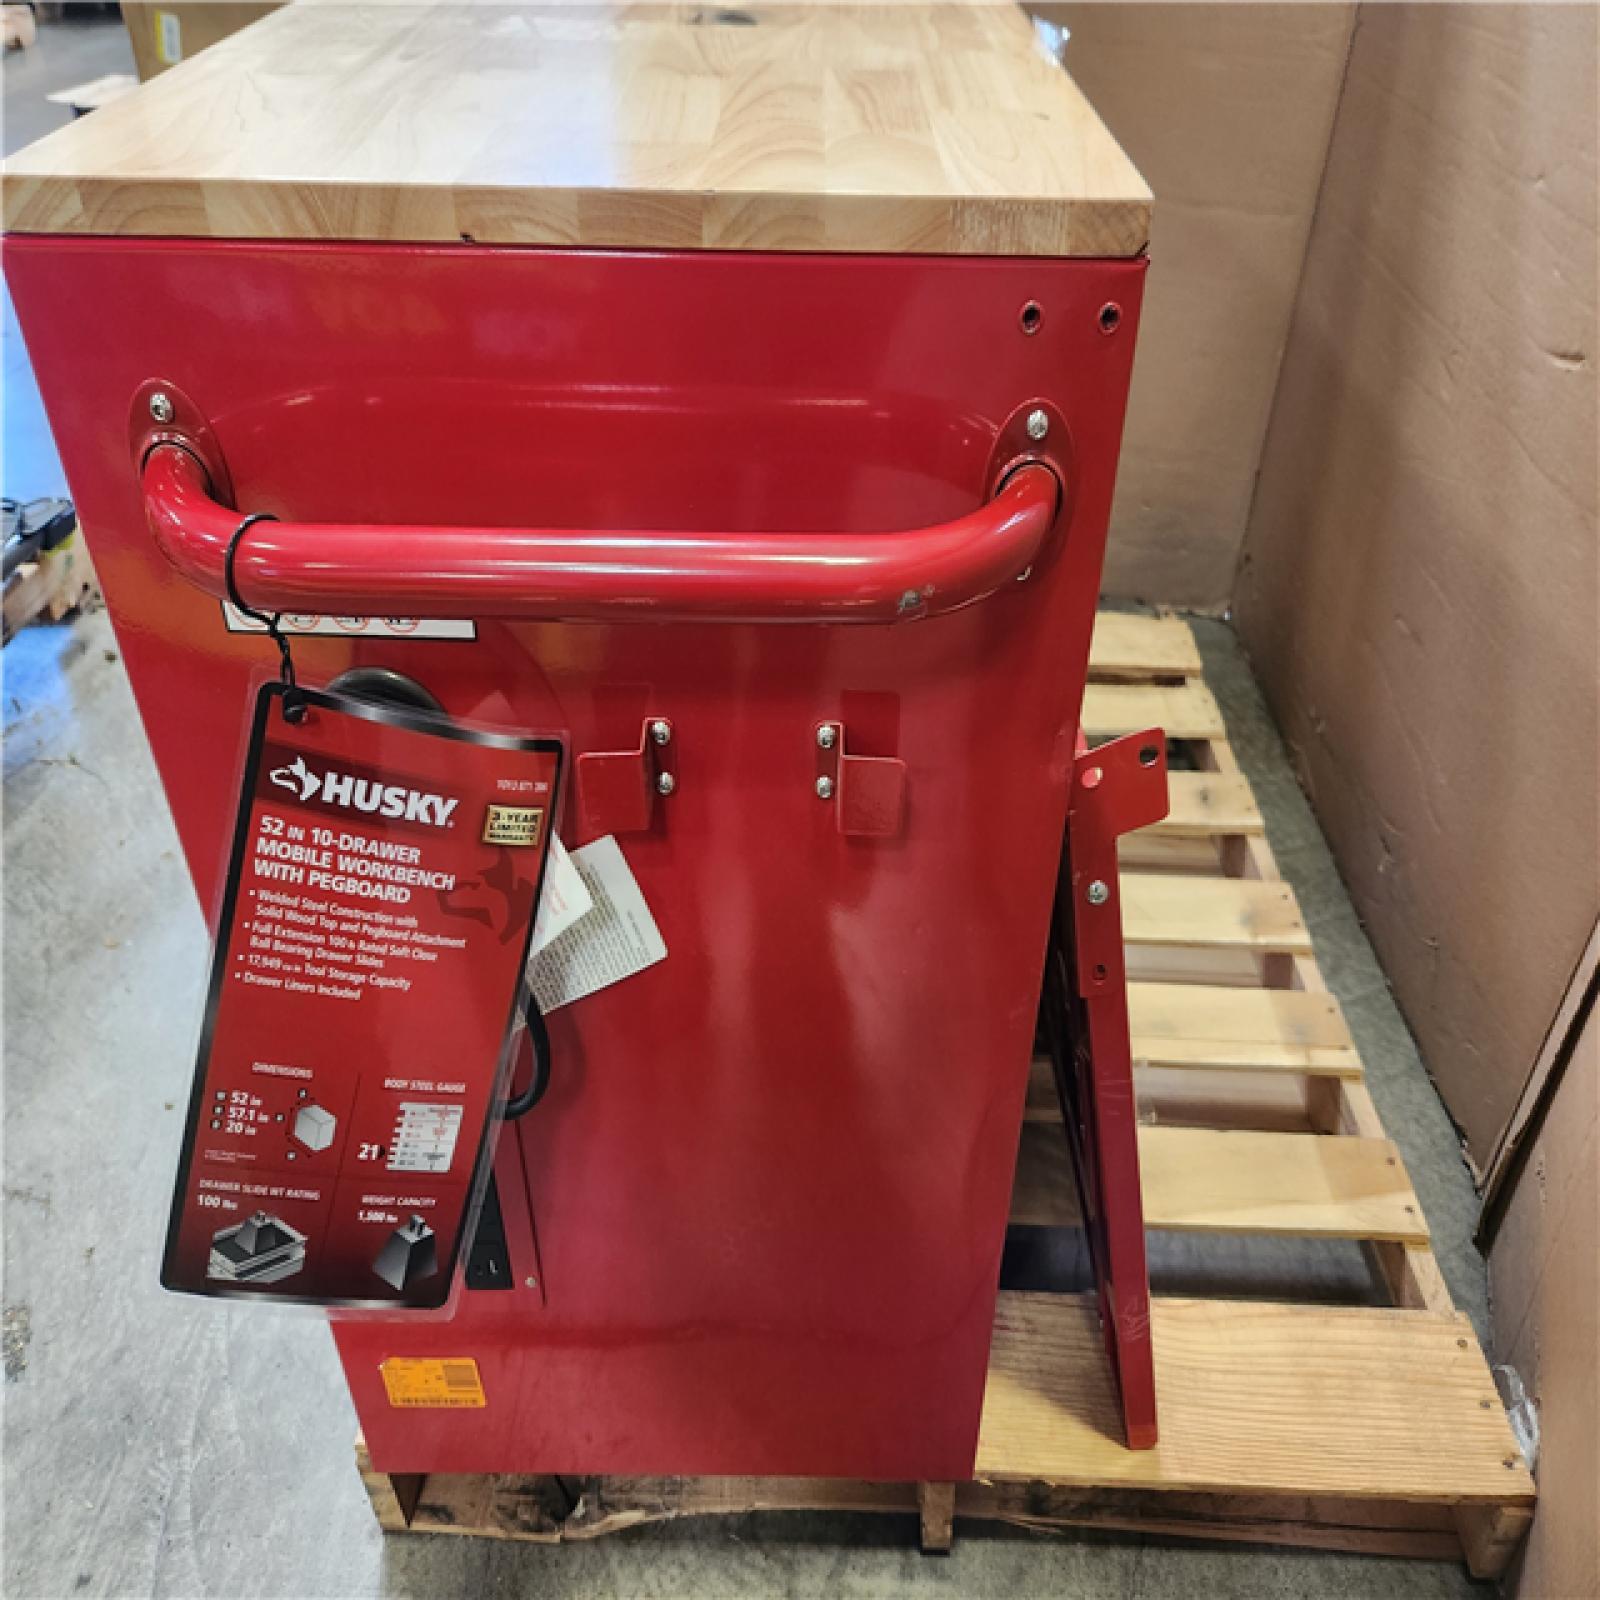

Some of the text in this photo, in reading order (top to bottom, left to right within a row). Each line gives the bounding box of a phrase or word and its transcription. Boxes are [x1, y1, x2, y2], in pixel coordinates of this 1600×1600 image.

[321, 771, 458, 826] HUSKY
[260, 815, 284, 836] 52
[311, 827, 421, 865] 10-DRAWER
[256, 837, 456, 891] MOBILE WORKBENCH
[253, 858, 411, 903] WITH PEGBOARD
[258, 889, 418, 928] Welded Steel Construction with
[252, 920, 273, 935] Full
[274, 924, 326, 944] Extension
[359, 939, 388, 955] Rated
[389, 944, 411, 957] Soft
[412, 948, 438, 961] Close
[256, 904, 466, 948] Solid Wood Top and Pegboard Attachment
[250, 934, 384, 968] Ball Bearing Drawer Slides
[244, 971, 361, 1000] Drawer Liners Included
[304, 962, 326, 977] Tool
[327, 967, 366, 984] Storage
[369, 973, 411, 992] Capacity
[252, 1062, 313, 1079] DIMENSIONS
[229, 1090, 249, 1106] 52
[384, 1077, 466, 1094] BODY STEEL GAUGE
[224, 1120, 244, 1135] 20
[358, 1143, 379, 1160] 21
[197, 1194, 221, 1208] 100
[199, 1178, 241, 1192] DRAWER
[242, 1183, 269, 1196] SLIDE
[286, 1187, 320, 1200] RATING
[361, 1193, 436, 1208] WEIGHT CAPACITY
